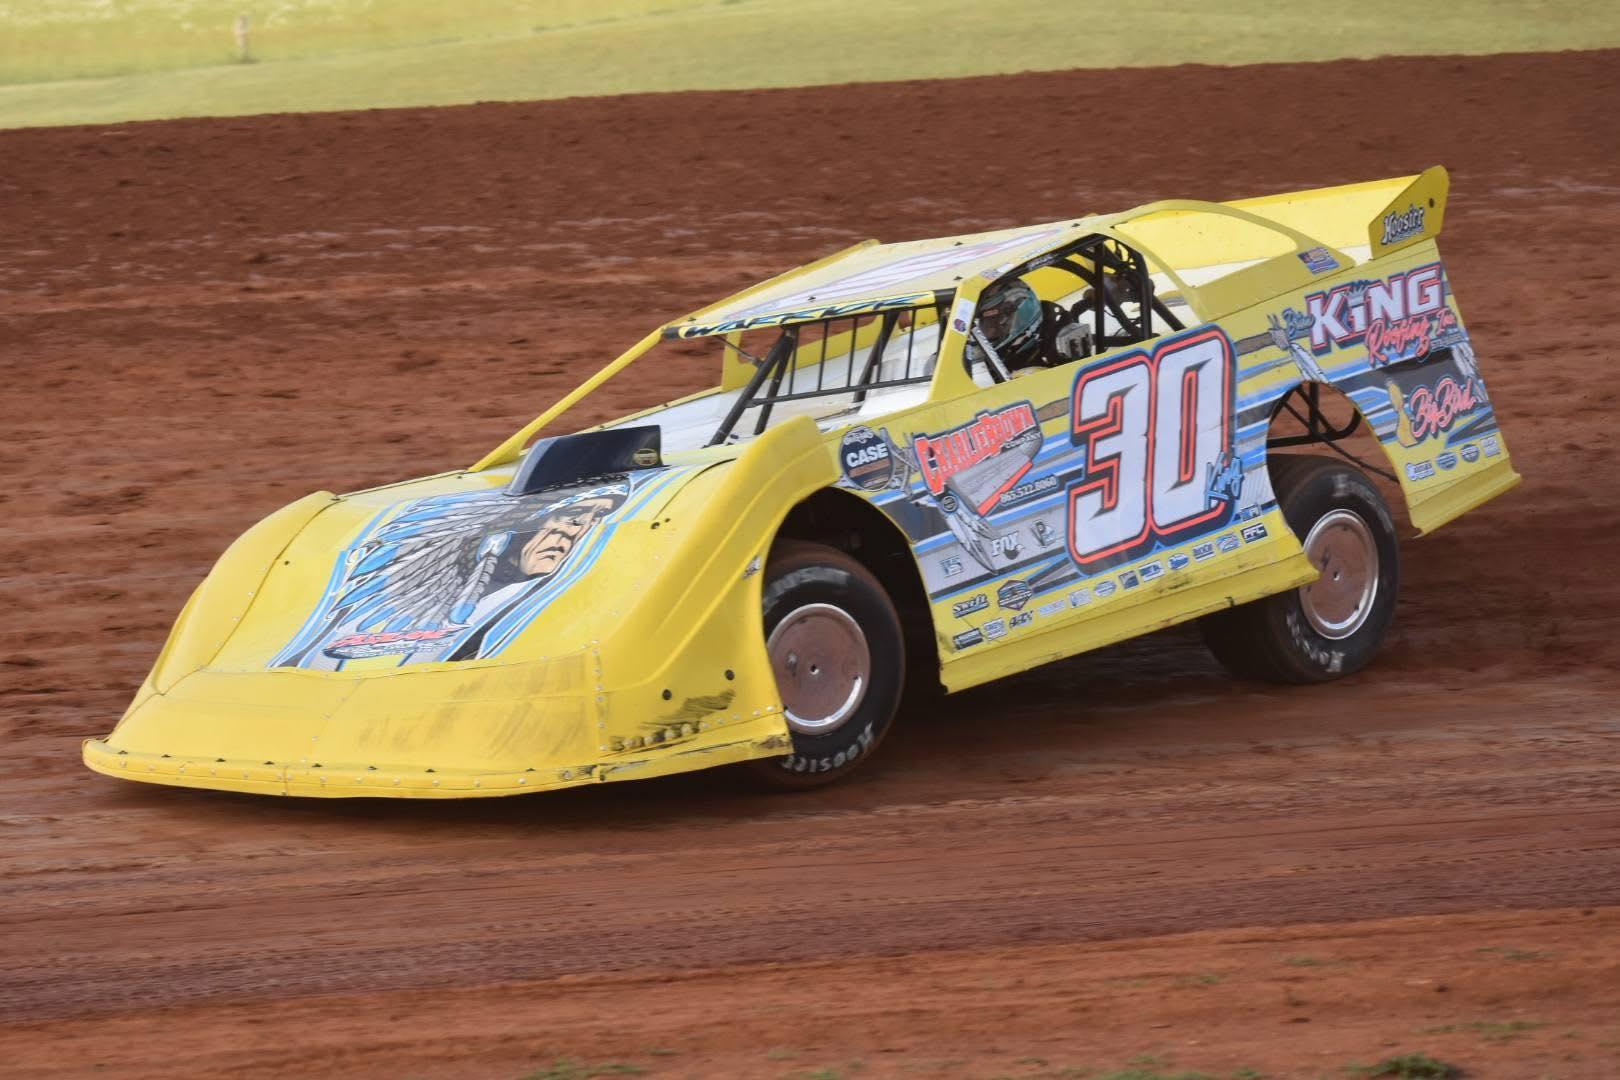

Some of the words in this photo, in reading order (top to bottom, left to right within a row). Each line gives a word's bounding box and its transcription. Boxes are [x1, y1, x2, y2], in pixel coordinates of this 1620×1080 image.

[1380, 203, 1424, 245] Hoosier
[846, 443, 889, 468] CASE
[1068, 329, 1231, 564] 30
[1242, 525, 1265, 540] PFC
